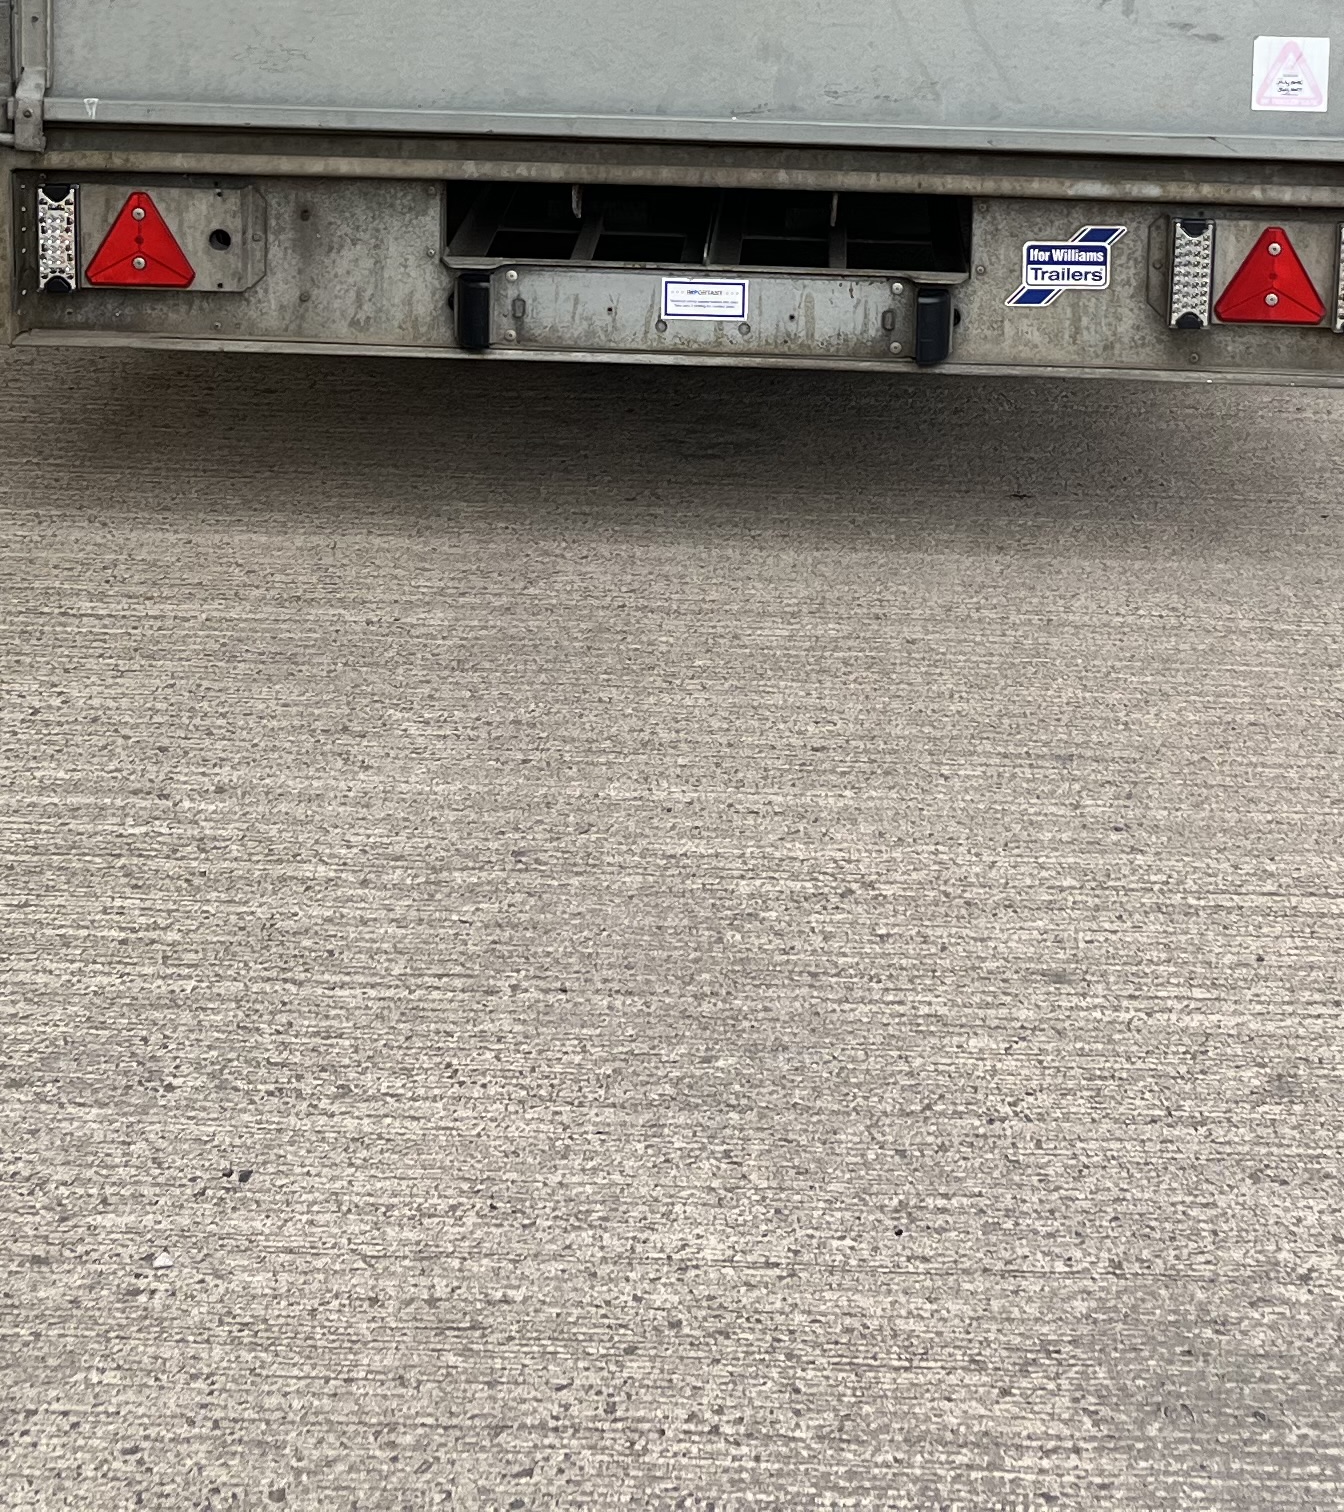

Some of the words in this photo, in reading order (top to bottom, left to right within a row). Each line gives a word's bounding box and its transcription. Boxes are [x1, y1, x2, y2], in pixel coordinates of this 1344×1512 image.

[1029, 248, 1050, 262] Ifor
[1052, 248, 1104, 262] Williams
[1030, 267, 1103, 281] Trailers
